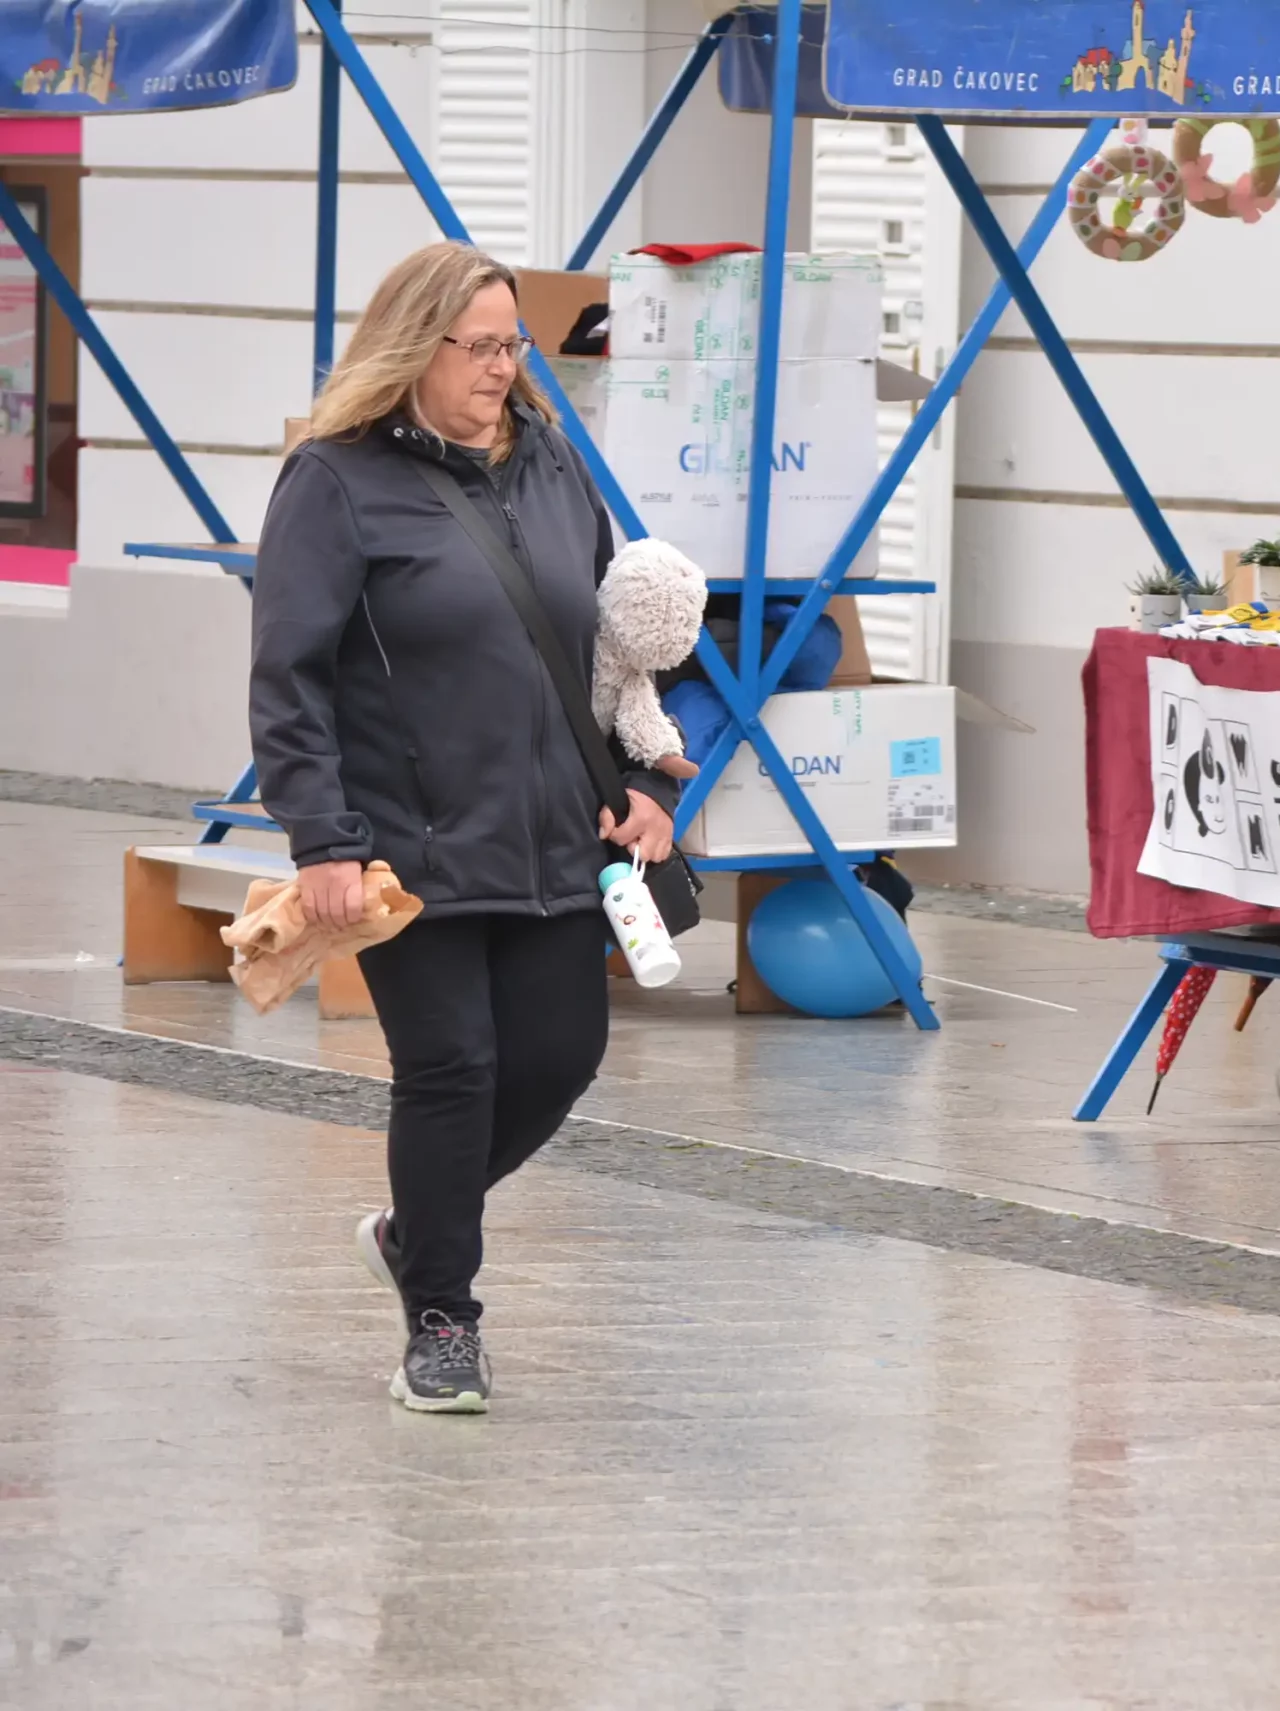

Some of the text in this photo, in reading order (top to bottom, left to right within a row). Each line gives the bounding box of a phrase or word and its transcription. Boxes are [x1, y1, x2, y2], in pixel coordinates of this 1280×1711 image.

[142, 65, 260, 95] GRAD ČAKOVEC
[893, 65, 1039, 92] GRAD ČAKOVEC
